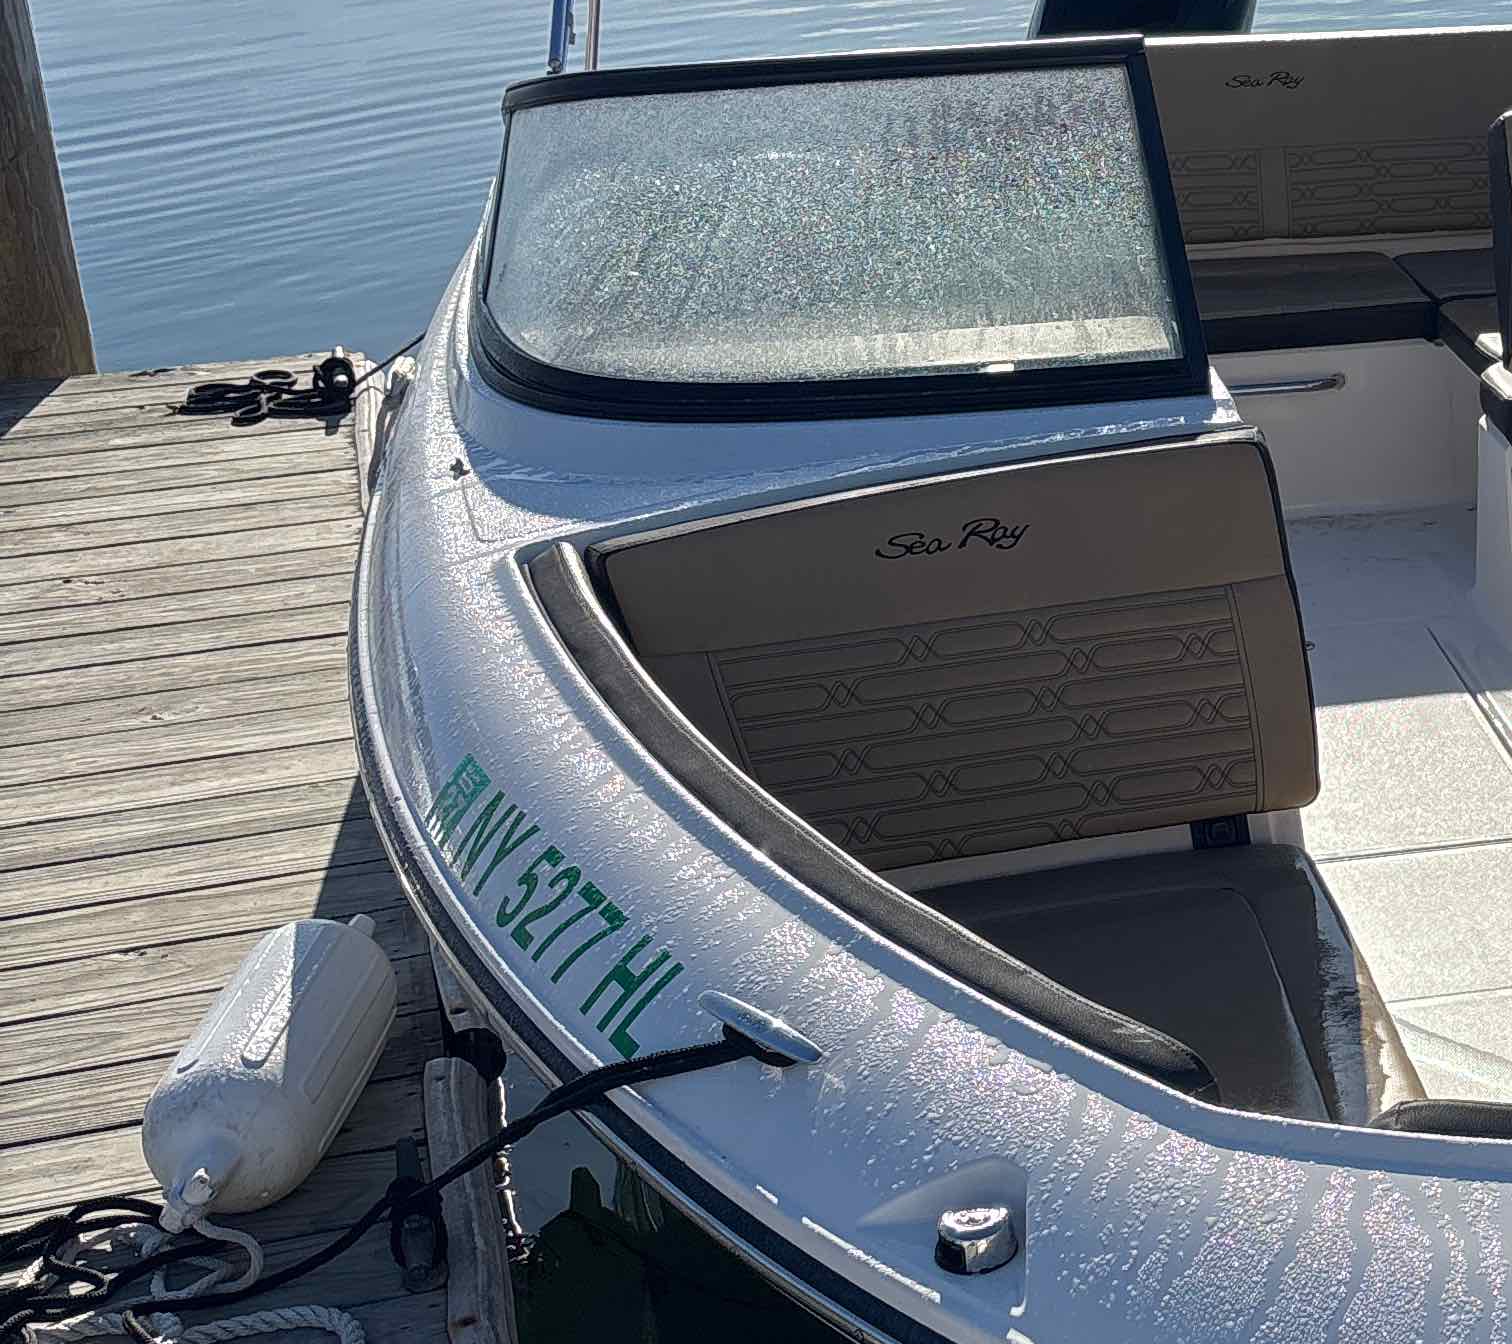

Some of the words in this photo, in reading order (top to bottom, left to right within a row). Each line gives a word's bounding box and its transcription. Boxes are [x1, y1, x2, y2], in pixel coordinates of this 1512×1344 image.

[1225, 74, 1264, 89] Sea
[1266, 71, 1305, 89] Ray
[875, 532, 952, 560] Sea
[957, 517, 1030, 550] Ray
[451, 789, 541, 897] NY
[495, 844, 630, 985] 5277
[579, 933, 686, 1059] HL
